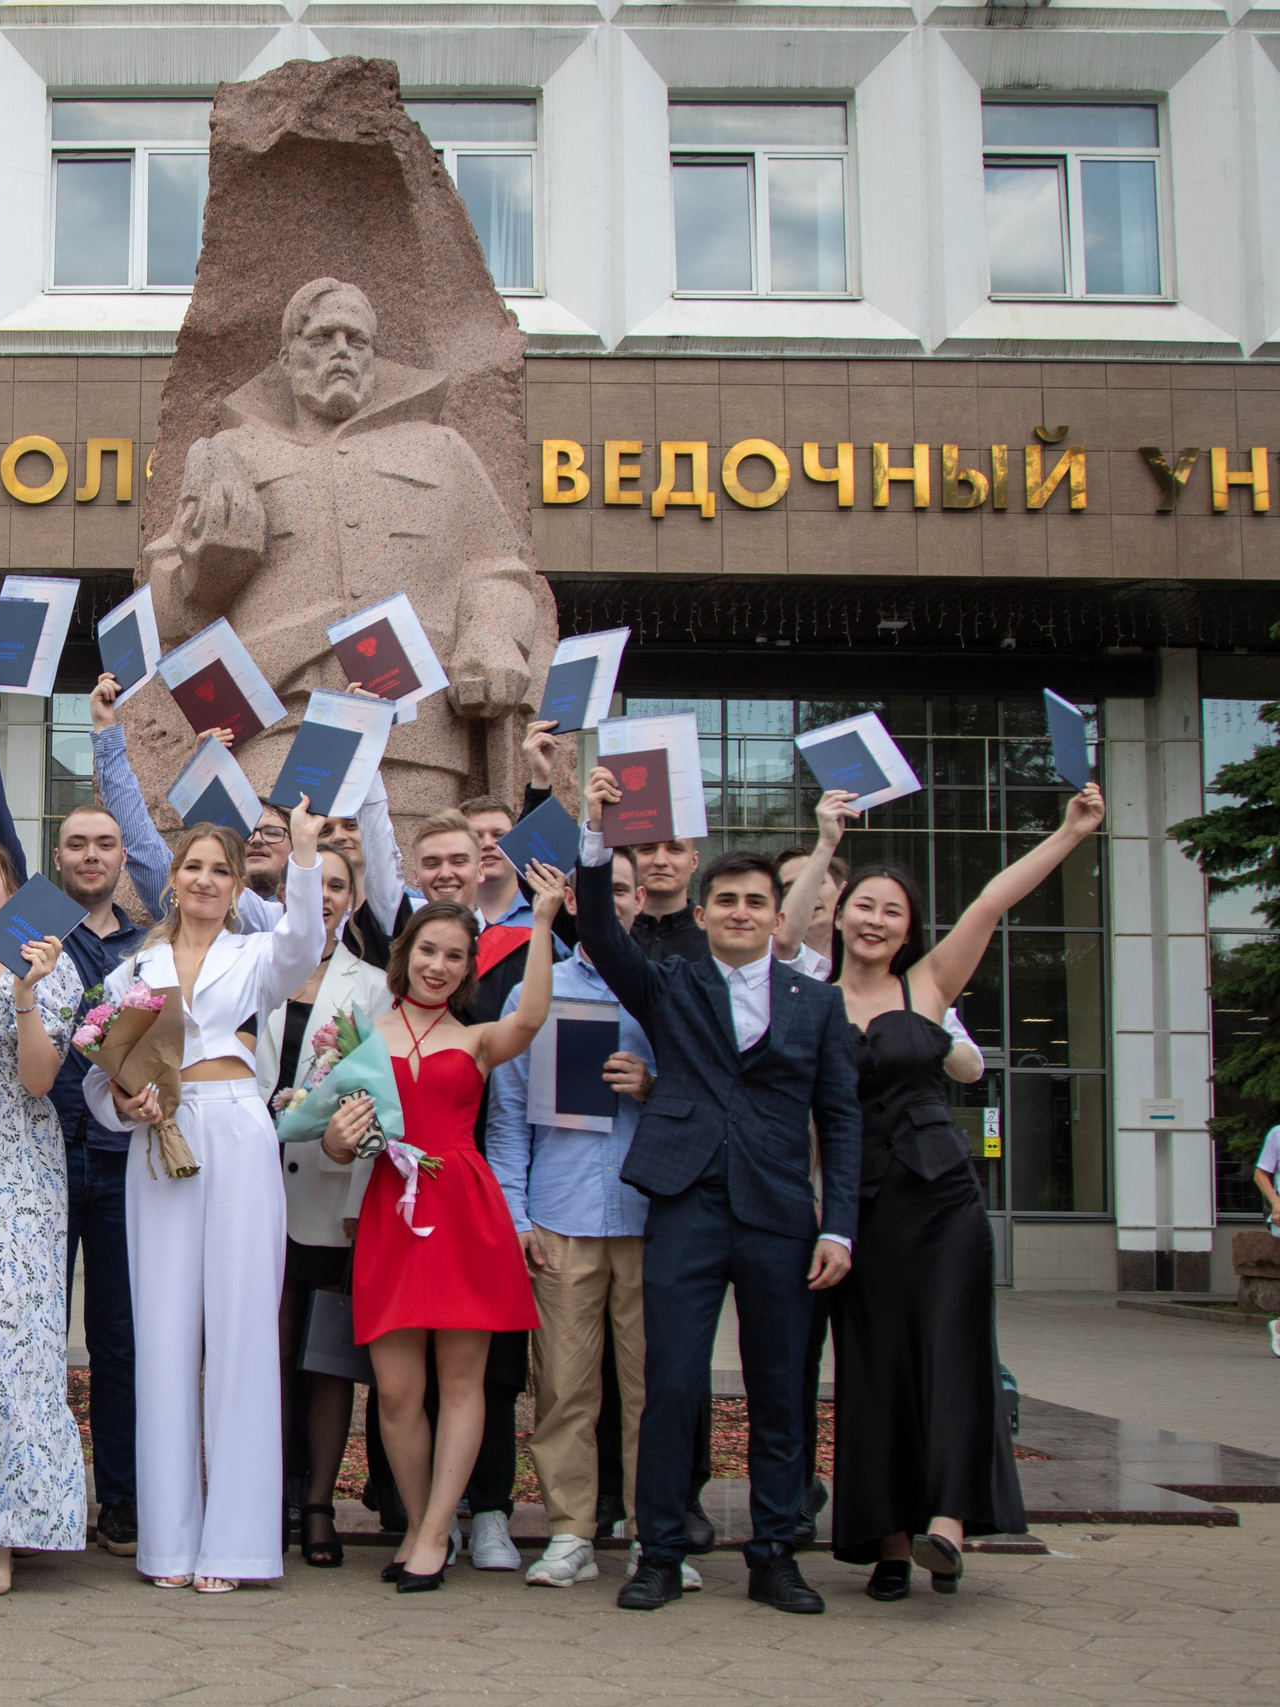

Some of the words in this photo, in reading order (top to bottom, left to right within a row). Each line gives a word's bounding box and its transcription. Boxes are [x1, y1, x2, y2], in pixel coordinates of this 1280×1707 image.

[542, 425, 1087, 518] ВЕДОЧНЫЙ
[618, 809, 658, 820] ДИПЛОМ
[10, 914, 42, 940] ДИПЛОМ
